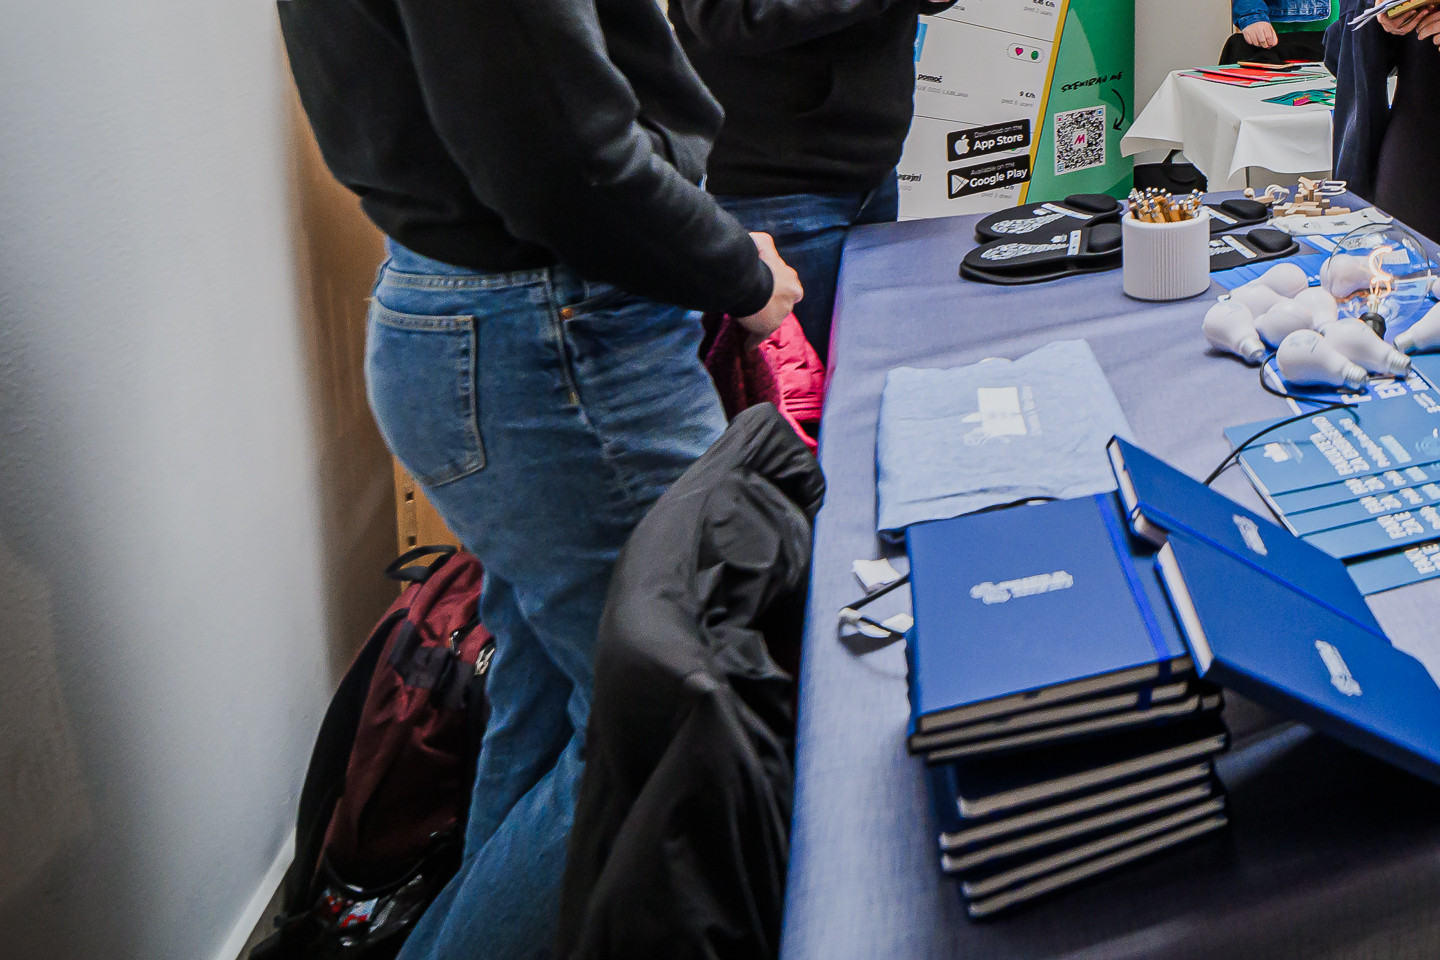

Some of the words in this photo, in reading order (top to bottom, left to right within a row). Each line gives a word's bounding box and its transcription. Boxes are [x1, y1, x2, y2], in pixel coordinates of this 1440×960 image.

[973, 139, 995, 151] App
[996, 133, 1024, 145] Store
[969, 172, 1005, 188] Google
[1006, 168, 1028, 179] Play
